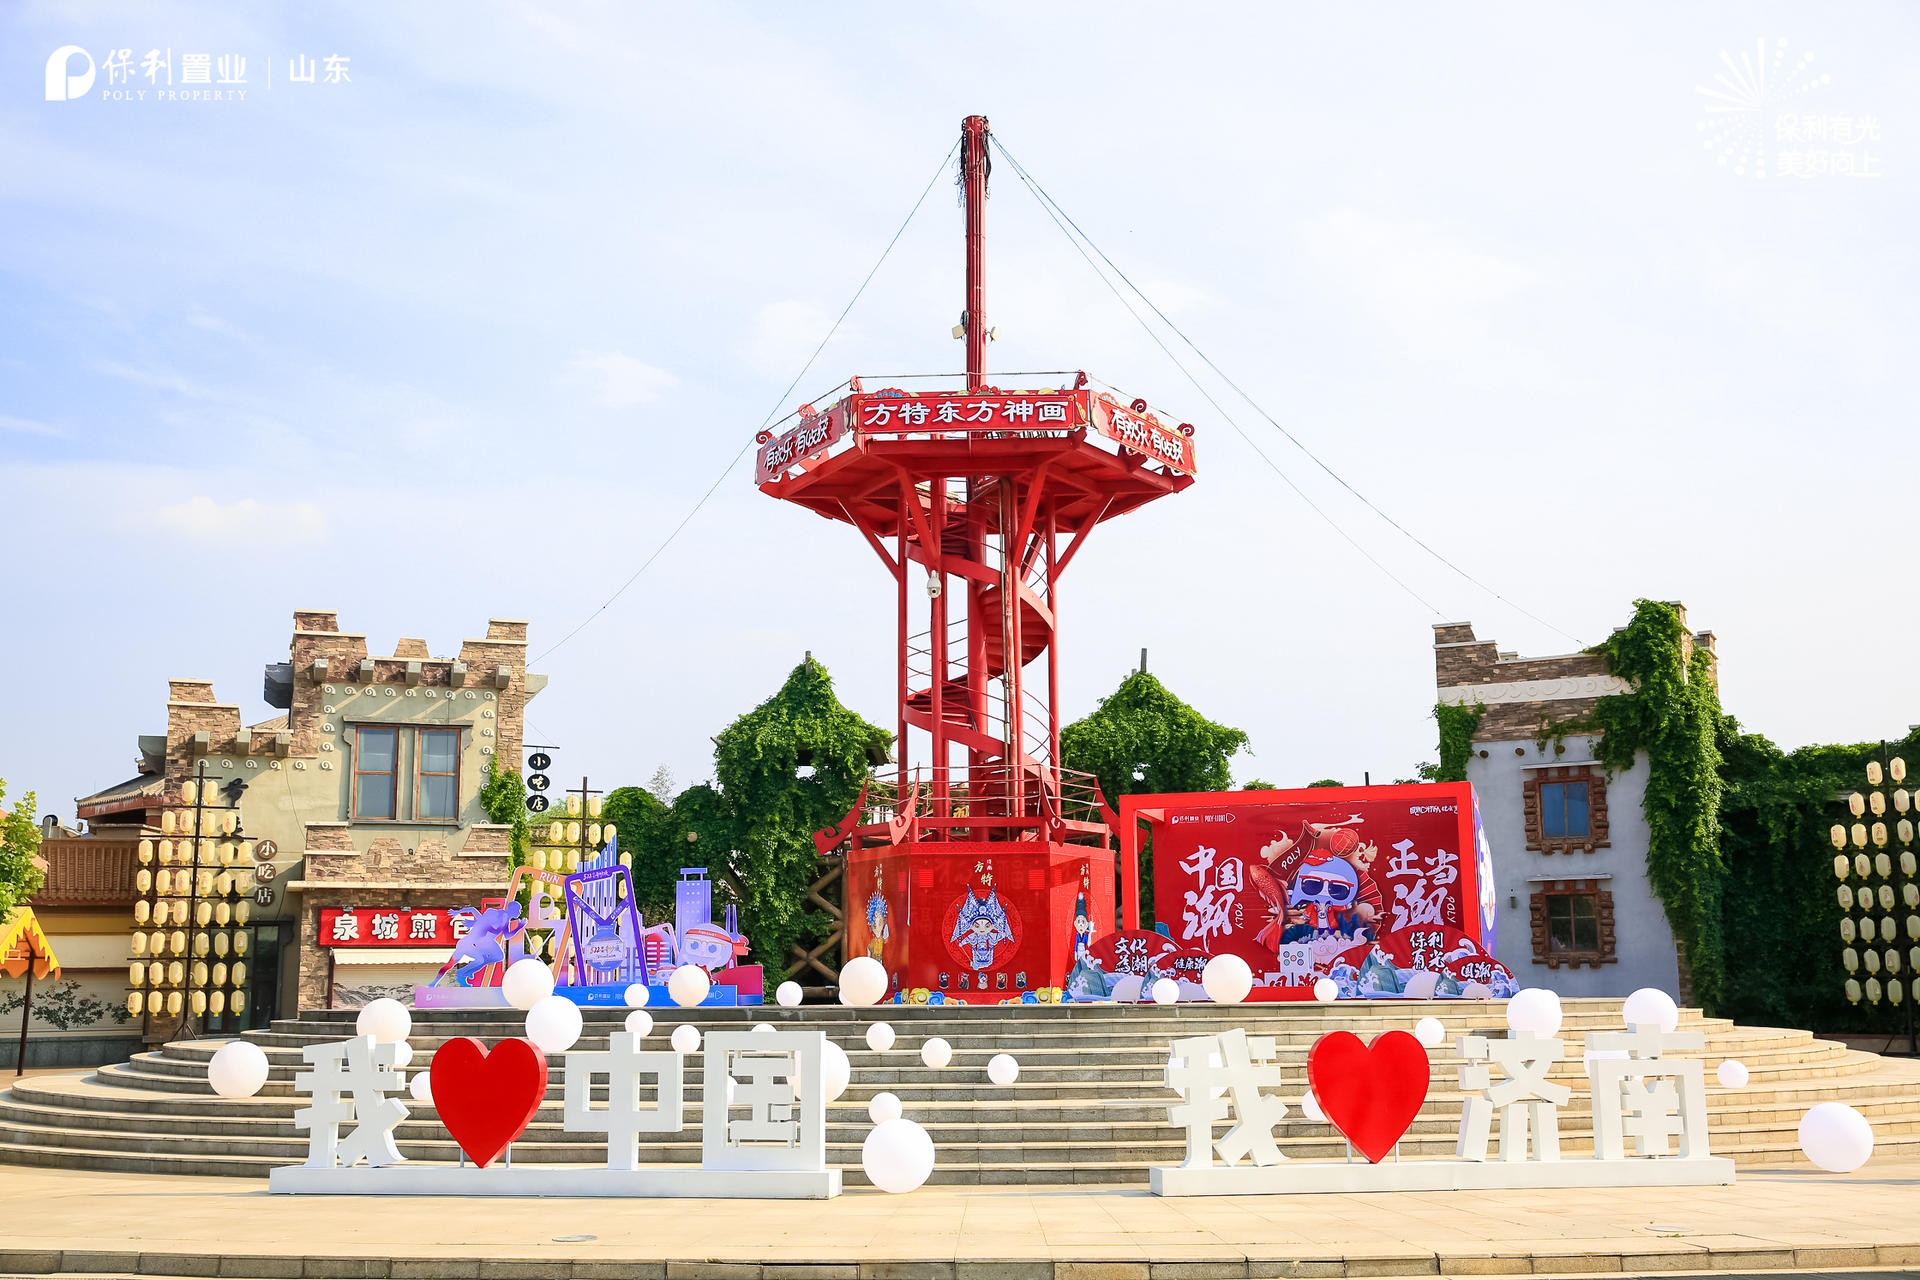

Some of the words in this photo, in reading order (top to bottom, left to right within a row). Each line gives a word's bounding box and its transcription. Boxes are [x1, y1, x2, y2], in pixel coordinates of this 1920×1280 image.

[864, 399, 1070, 426] 方特东方神画
[530, 755, 546, 811] 小吃店
[1178, 845, 1244, 893] 中国
[1280, 846, 1301, 870] POLY
[1385, 838, 1459, 885] 正当
[257, 841, 277, 904] 小吃店
[539, 871, 560, 884] RUN
[974, 860, 993, 887] 方特
[1234, 902, 1244, 930] POLY
[1446, 895, 1456, 924] POLY
[1113, 936, 1149, 955] 文化
[1409, 931, 1444, 949] 保利
[1411, 948, 1446, 970] 有光
[294, 1034, 411, 1167] 我
[563, 1031, 827, 1171] 中国
[1164, 1028, 1289, 1169] 我
[1455, 1023, 1710, 1162] 济南
